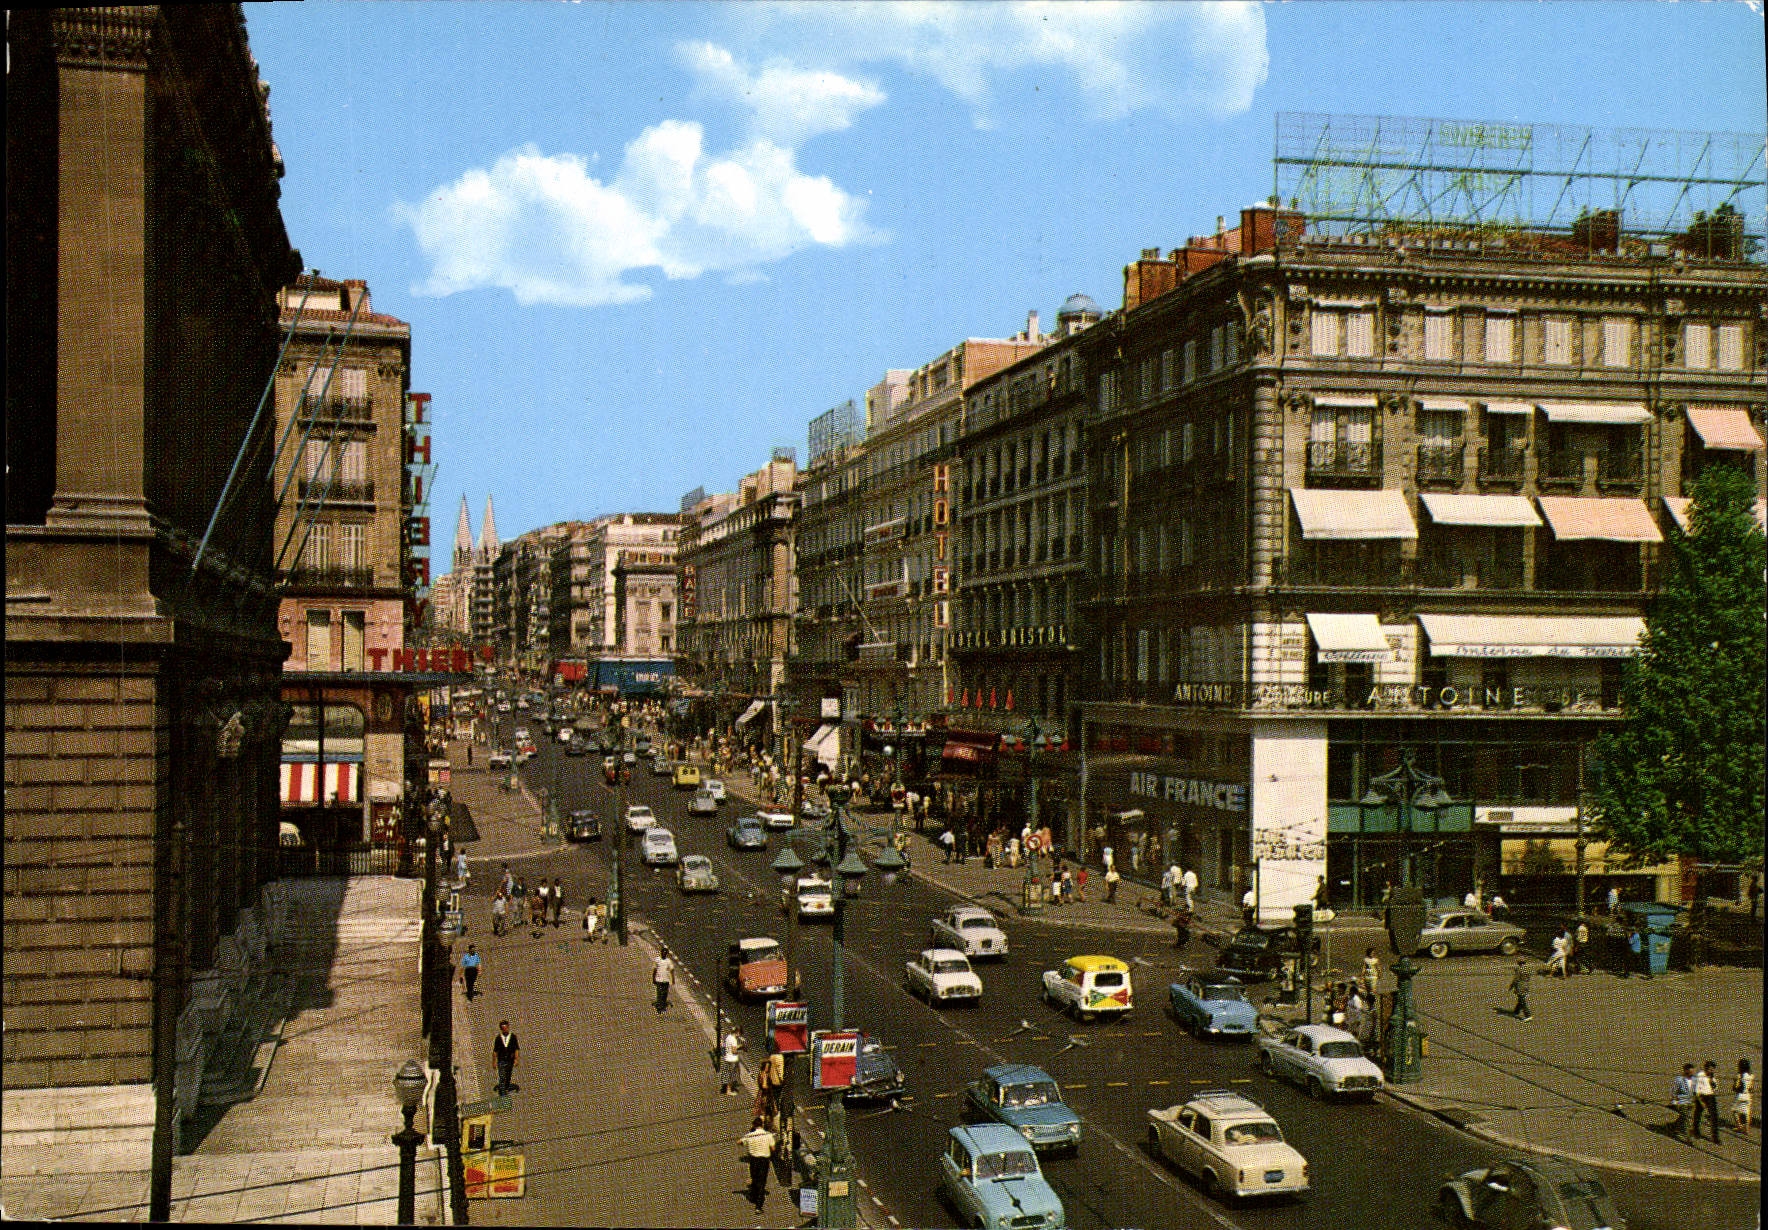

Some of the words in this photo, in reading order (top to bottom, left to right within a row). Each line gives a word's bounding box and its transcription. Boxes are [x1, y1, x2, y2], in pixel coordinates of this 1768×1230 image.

[1001, 625, 1066, 646] BRISTOL
[1130, 772, 1157, 798] AIR
[1165, 777, 1247, 812] FRANCE
[822, 1042, 856, 1054] DERAIN
